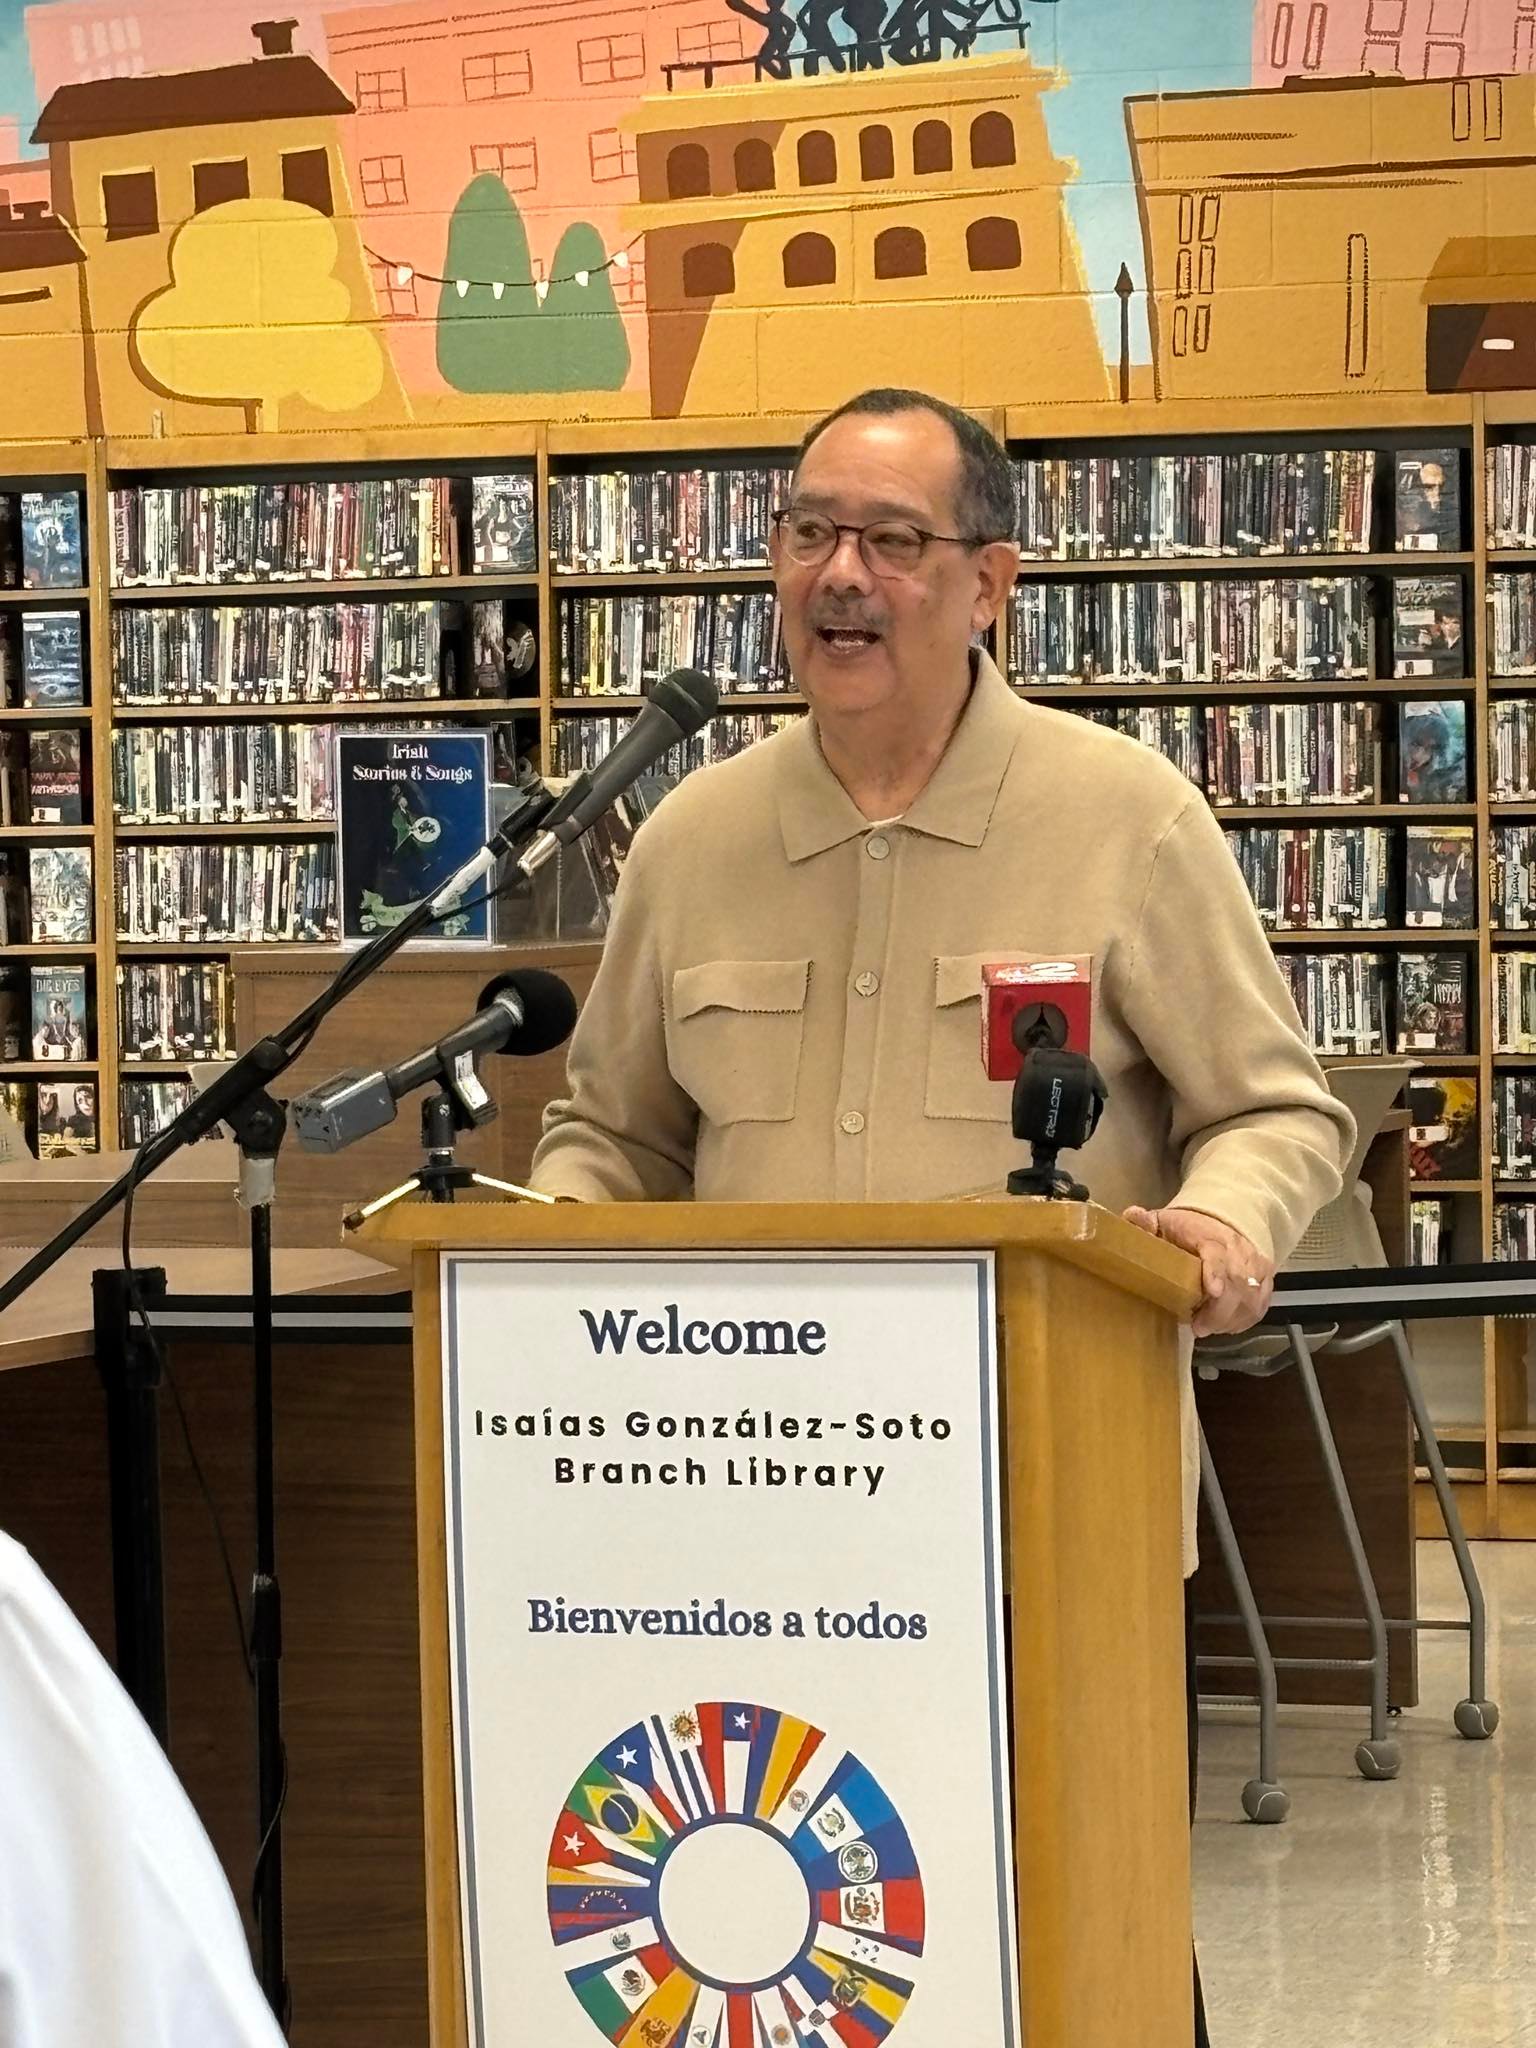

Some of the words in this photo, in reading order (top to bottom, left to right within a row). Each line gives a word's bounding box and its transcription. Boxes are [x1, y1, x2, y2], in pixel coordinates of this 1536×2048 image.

[392, 744, 429, 759] Irish
[353, 765, 407, 780] Stories
[410, 766, 422, 780] &
[425, 765, 473, 784] Songs
[579, 1304, 826, 1355] Welcome
[476, 1407, 605, 1437] Isaías
[626, 1408, 950, 1440] González-Soto
[555, 1458, 705, 1485] Branch
[728, 1456, 884, 1496] Library
[528, 1597, 771, 1637] Bienvenidos
[783, 1612, 805, 1637] a
[815, 1601, 927, 1639] todos
